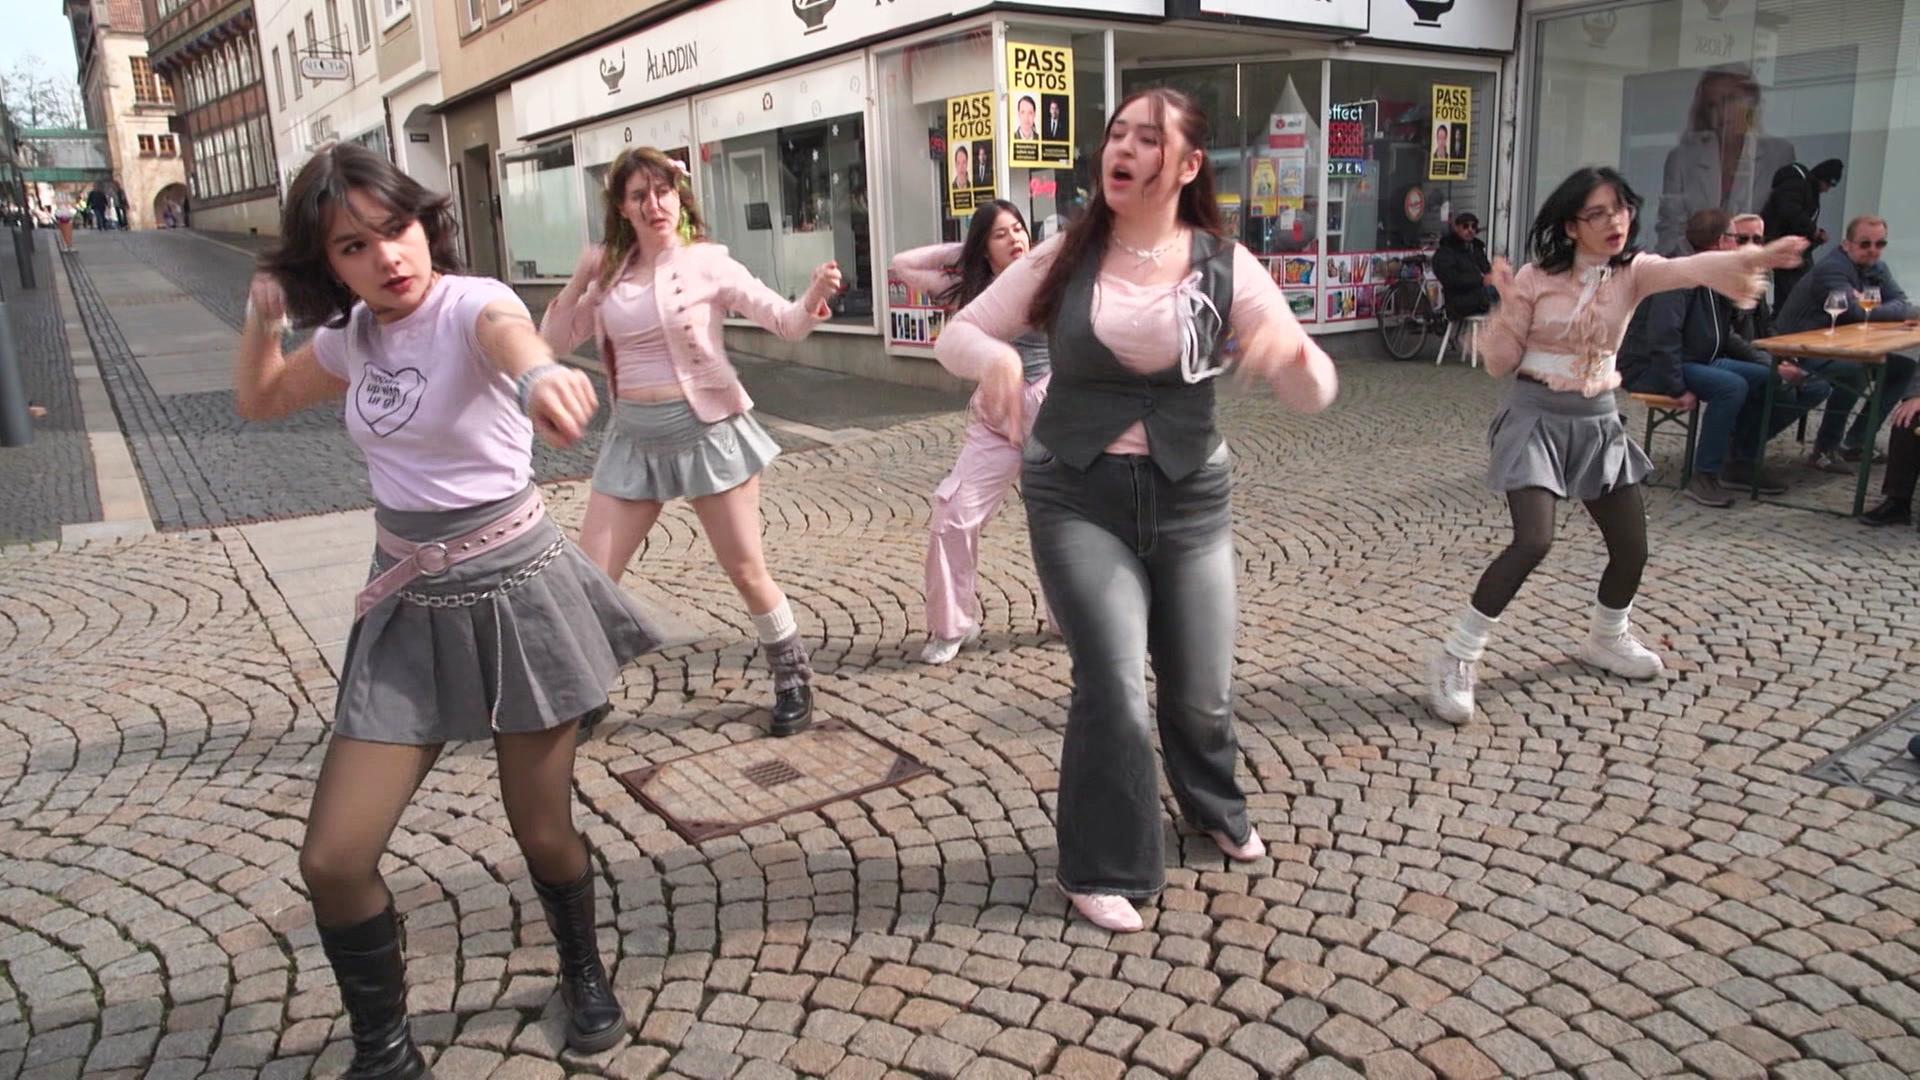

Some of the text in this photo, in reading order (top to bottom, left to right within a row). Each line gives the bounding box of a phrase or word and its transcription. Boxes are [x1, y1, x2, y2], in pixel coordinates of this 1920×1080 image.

[646, 40, 698, 82] ALADDIN
[1014, 48, 1066, 73] PASS
[1014, 72, 1067, 91] FOTOS
[1436, 88, 1467, 106] PASS
[952, 96, 991, 122] PASS
[1435, 105, 1467, 120] FOTOS
[952, 119, 992, 139] FOTOS
[1327, 162, 1362, 174] OPEN
